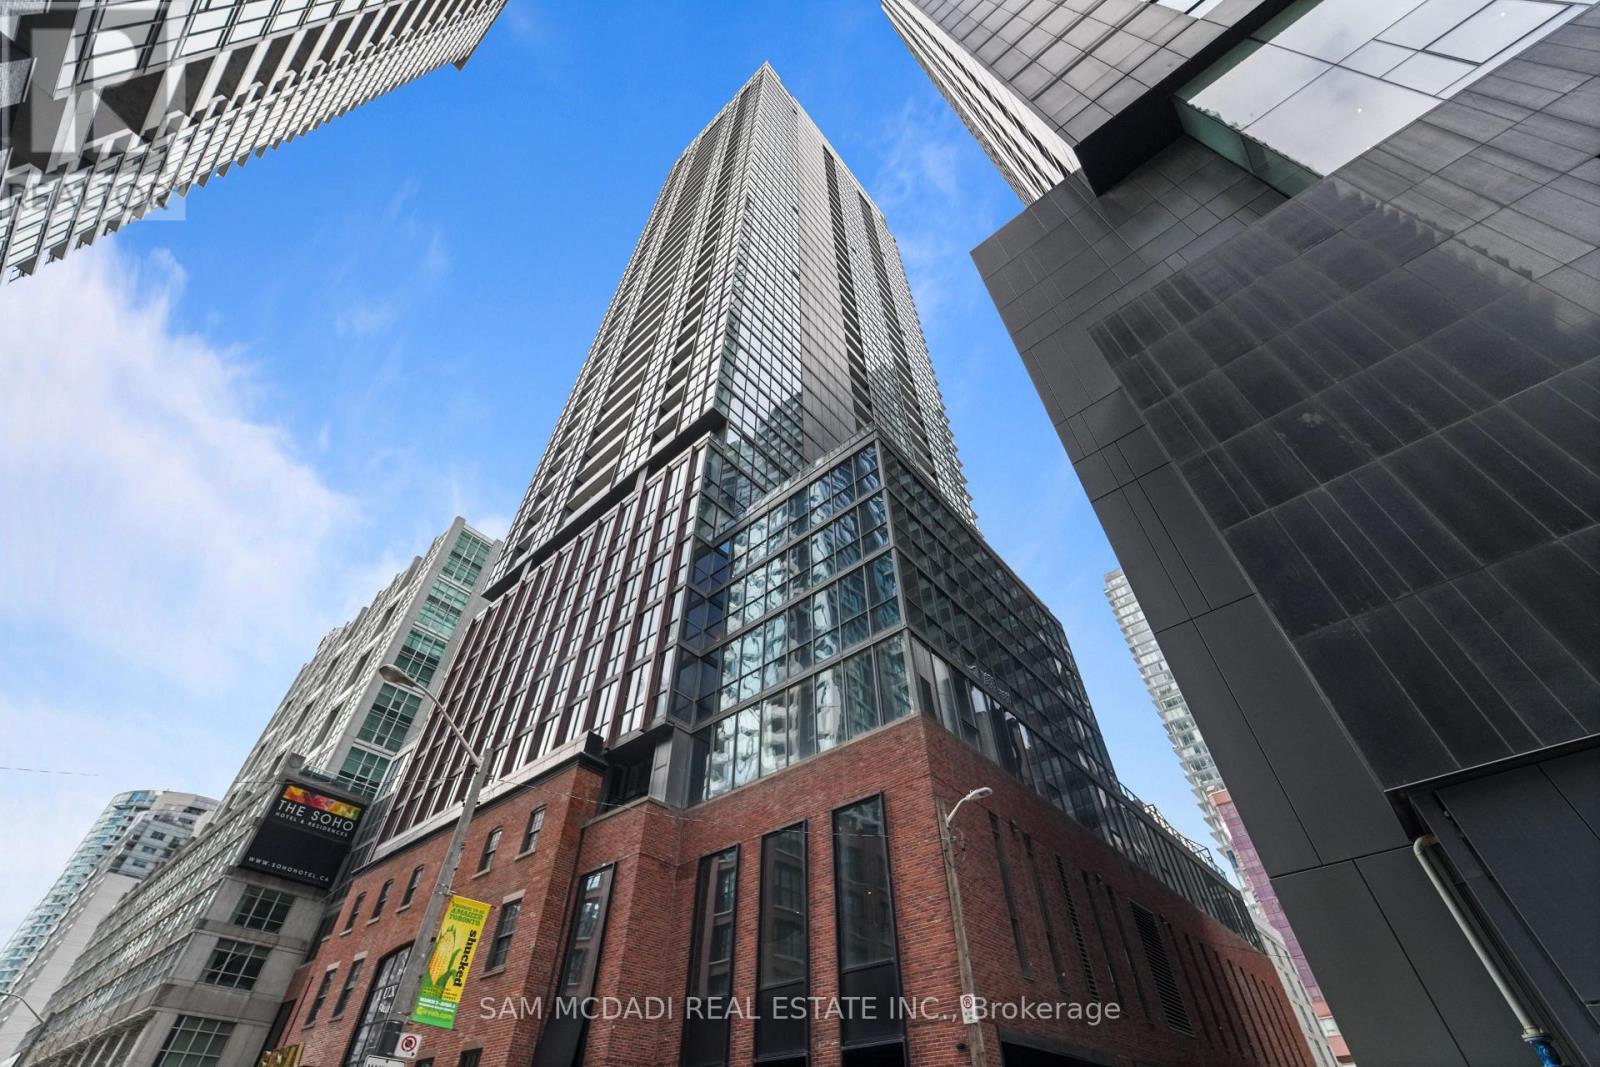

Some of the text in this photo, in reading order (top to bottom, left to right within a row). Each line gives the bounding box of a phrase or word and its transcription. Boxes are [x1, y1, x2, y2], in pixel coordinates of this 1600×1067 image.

[275, 811, 297, 823] HOTEL
[308, 821, 348, 837] RESIDENCES
[277, 799, 354, 832] THE SOHO
[248, 856, 329, 882] WWW.SOHOHOTEL.CA
[453, 929, 477, 988] shucked
